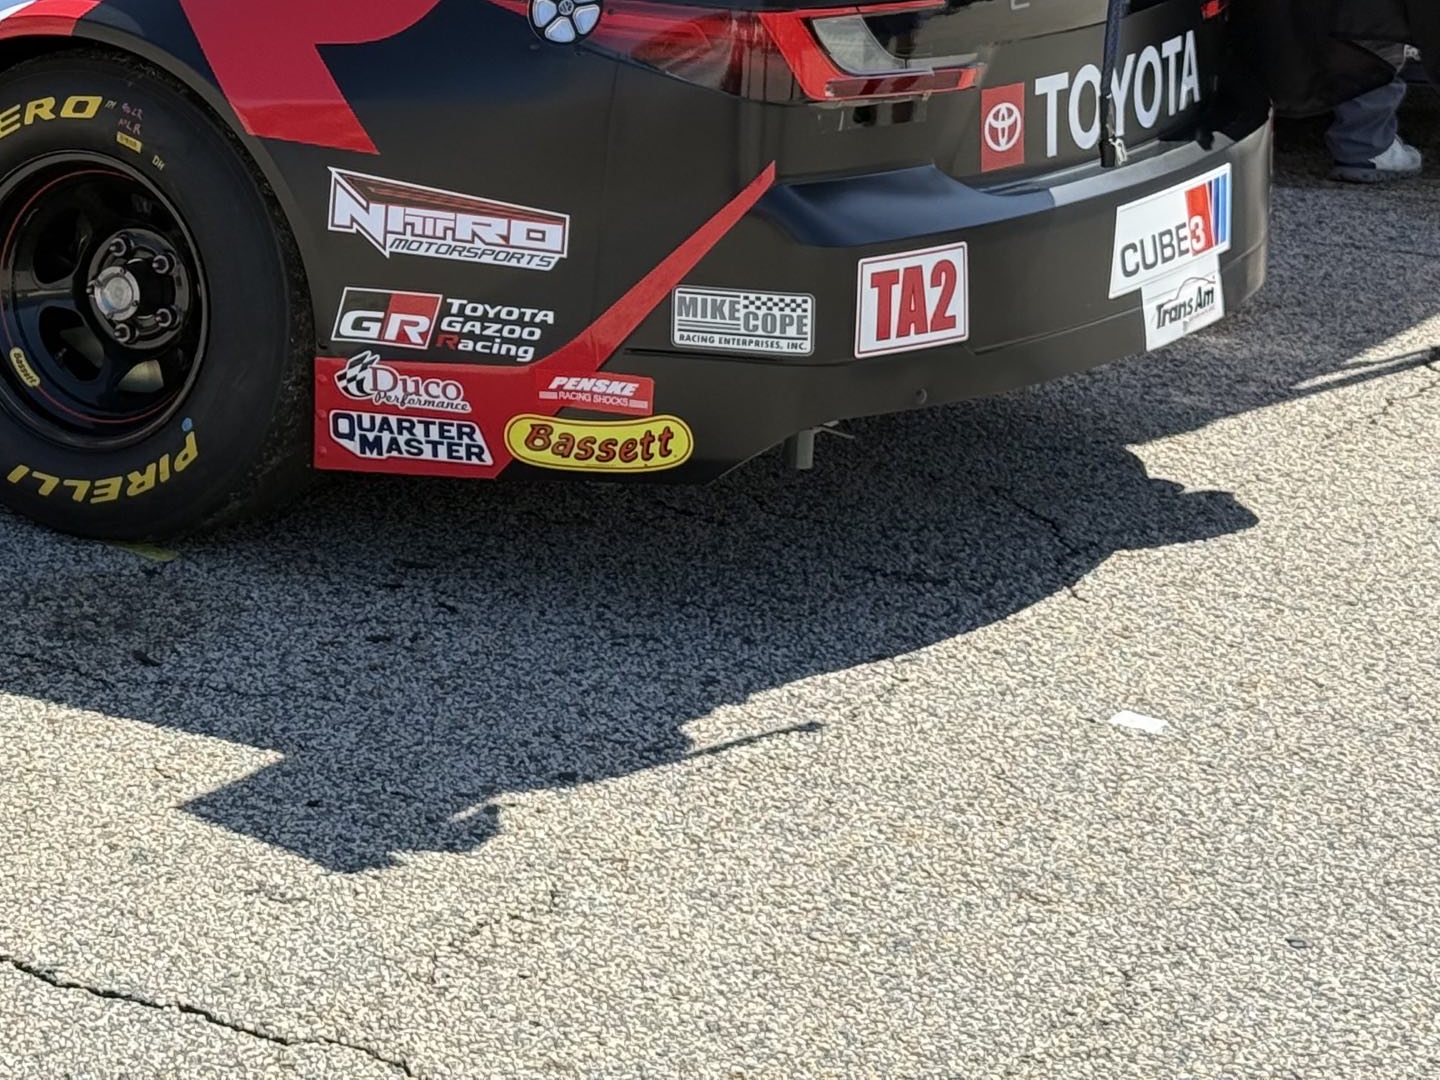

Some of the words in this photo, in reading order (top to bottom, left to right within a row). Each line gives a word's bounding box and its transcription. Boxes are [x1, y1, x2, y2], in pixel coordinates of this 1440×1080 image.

[1035, 29, 1201, 158] TOYOTA
[329, 168, 569, 258] NITRO
[388, 237, 555, 268] MOTORSPORTS
[1120, 214, 1207, 278] CUBE3
[446, 297, 555, 325] TOYOTA
[677, 295, 741, 321] MIKE
[870, 258, 958, 341] TA2
[1155, 293, 1194, 330] Trans
[1194, 285, 1216, 311] Am
[338, 308, 432, 344] GR
[440, 316, 542, 342] GAZOO
[742, 310, 808, 336] COPE
[436, 332, 536, 363] Racing
[678, 332, 715, 344] RACING
[718, 335, 784, 350] ENTERPRISES,
[786, 341, 808, 351] INC.
[370, 363, 463, 401] Duco
[548, 376, 640, 397] PENSKE
[374, 390, 471, 413] Performance
[558, 390, 592, 404] RACING
[593, 393, 630, 408] SHOCKS
[331, 412, 477, 444] QUARTER
[524, 422, 675, 463] Bassett
[361, 433, 486, 464] MASTER
[7, 430, 199, 505] PIRELLI
